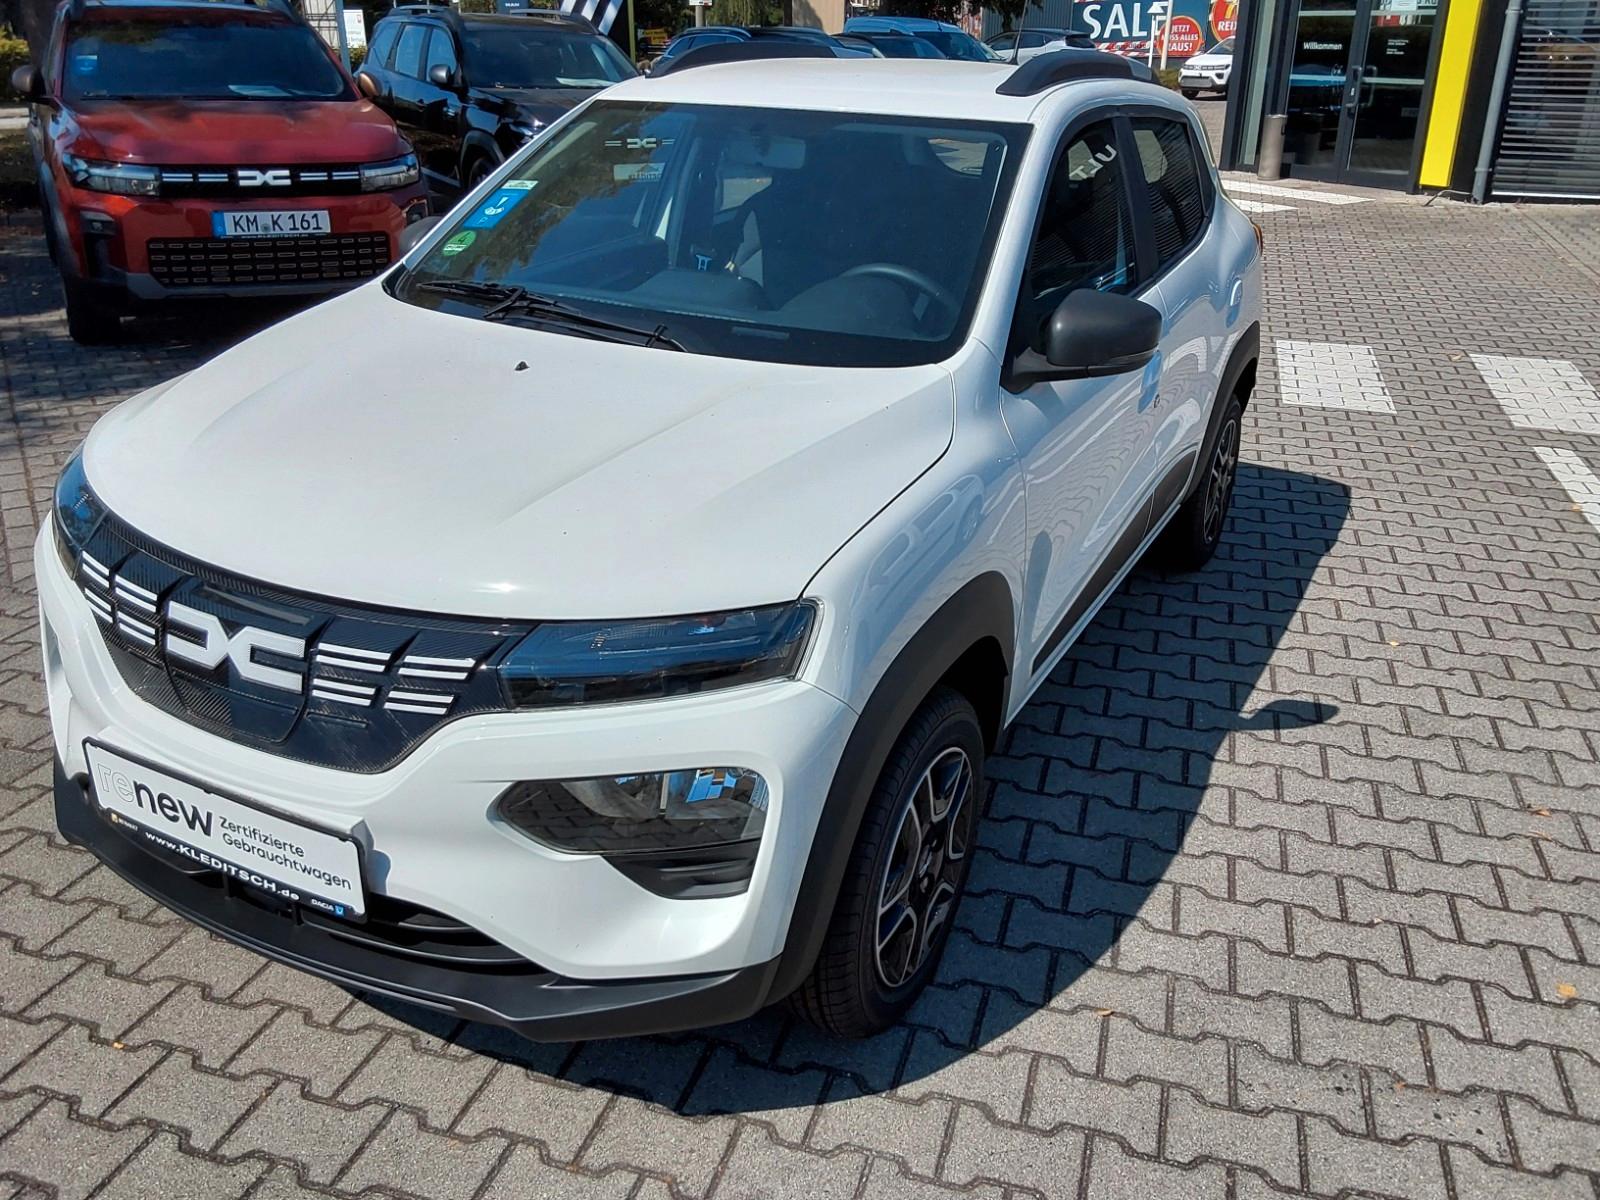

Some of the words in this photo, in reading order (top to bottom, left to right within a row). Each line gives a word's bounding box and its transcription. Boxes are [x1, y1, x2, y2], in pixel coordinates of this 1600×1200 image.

[1171, 24, 1190, 33] JETZT
[1180, 33, 1199, 41] ALLES
[1303, 42, 1342, 50] Willkommen
[232, 215, 259, 232] KM
[97, 763, 213, 837] renew
[218, 815, 305, 857] Zertifizierte
[145, 832, 300, 900] www.KLEDITSCH.de
[222, 833, 352, 890] Gebrauchtwagen
[311, 899, 334, 911] DACIA
